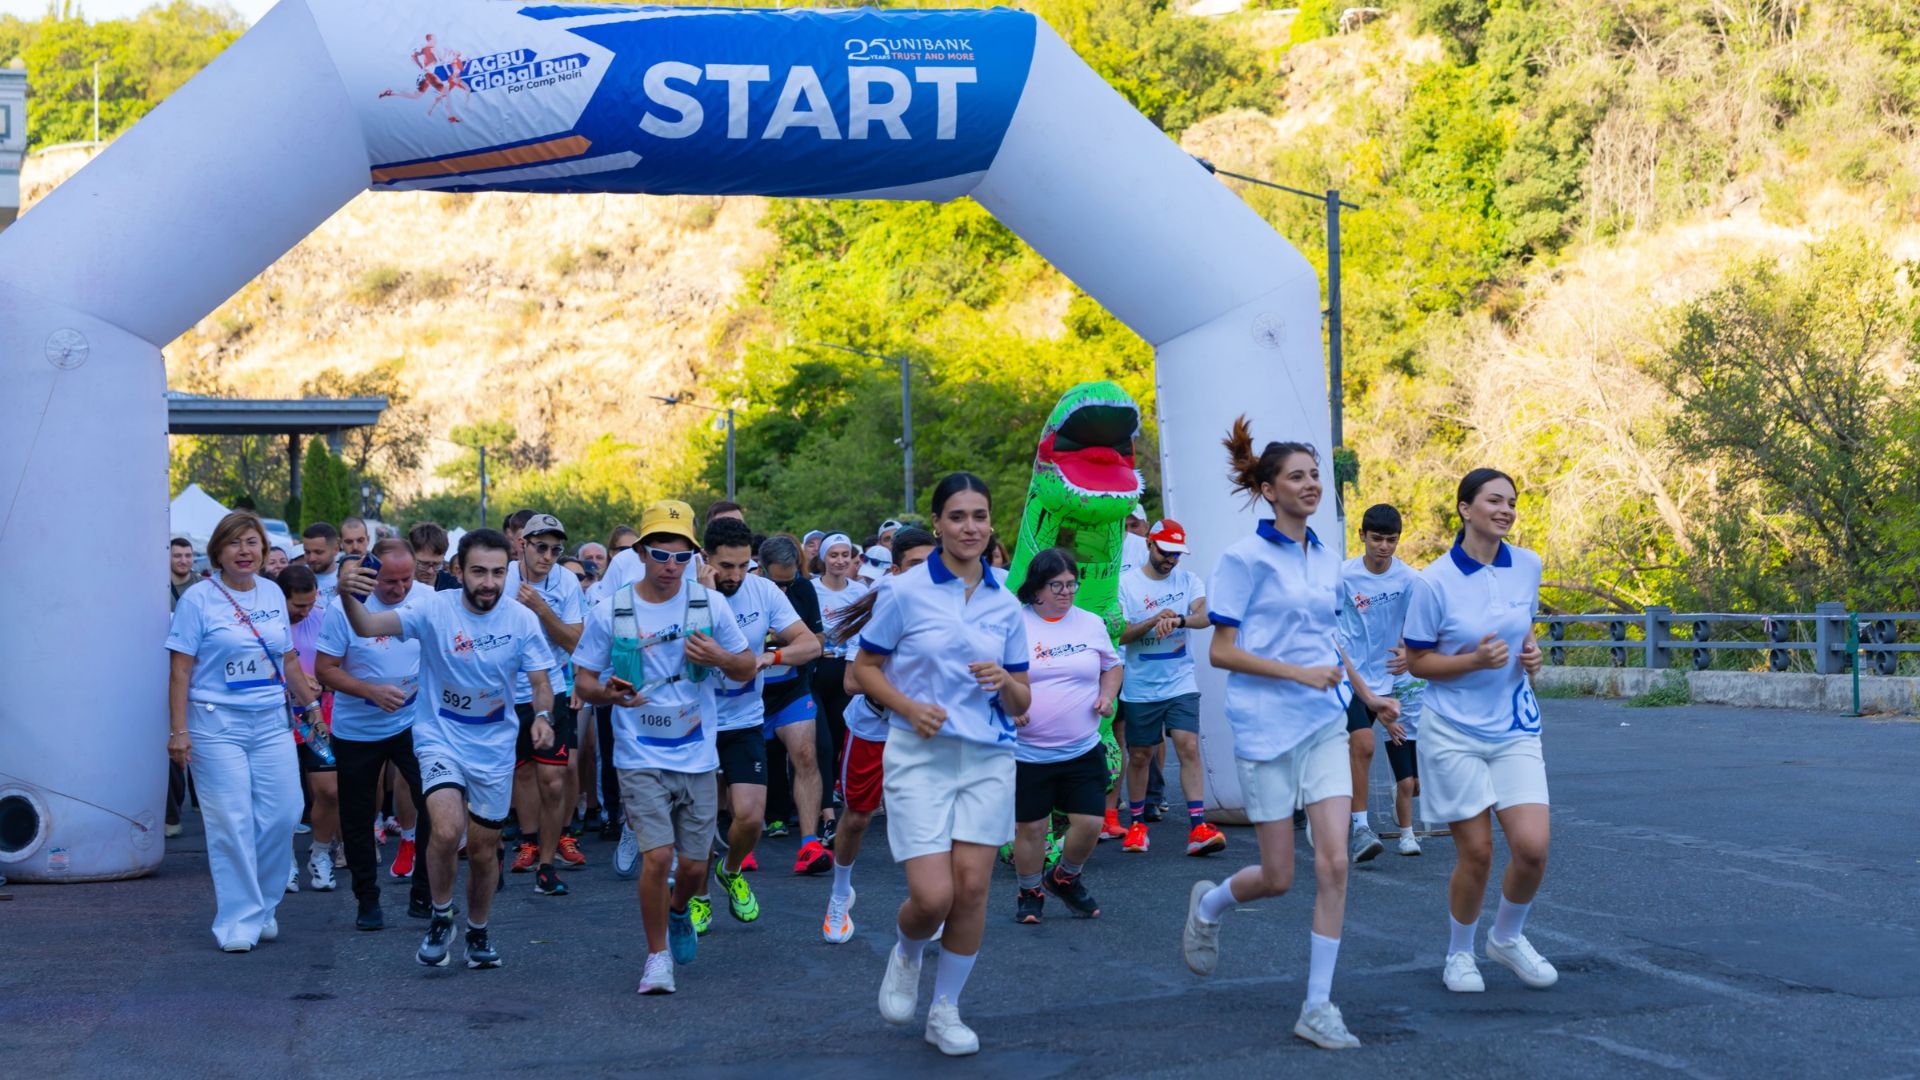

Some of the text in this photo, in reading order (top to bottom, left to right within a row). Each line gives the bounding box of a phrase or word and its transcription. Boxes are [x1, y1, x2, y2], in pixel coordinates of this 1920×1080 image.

[844, 38, 973, 60] 25 UNIBANK
[892, 52, 921, 60] TRUST
[948, 53, 975, 61] MORE
[468, 49, 525, 75] AGBU
[470, 57, 580, 91] Global Run
[508, 70, 582, 94] For Camp Nairi
[639, 61, 977, 140] START
[226, 660, 257, 676] 614
[443, 689, 472, 710] 592
[640, 714, 672, 728] 1086
